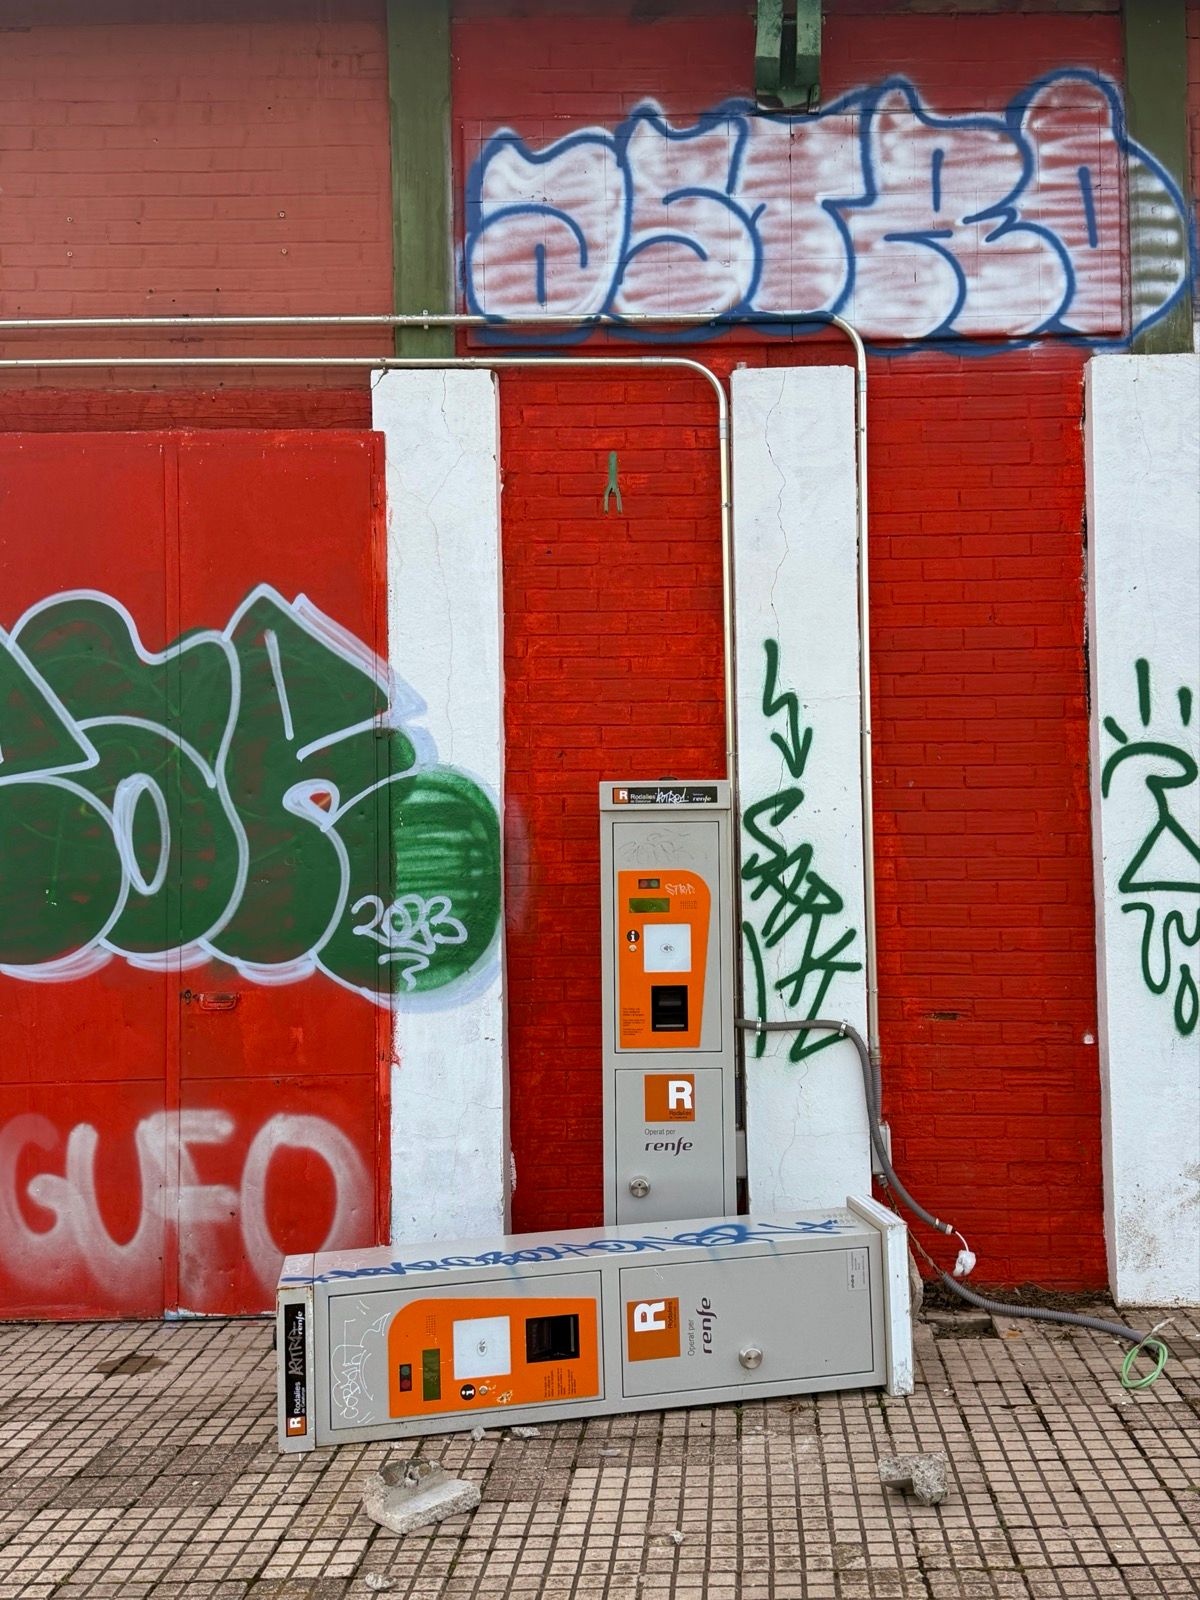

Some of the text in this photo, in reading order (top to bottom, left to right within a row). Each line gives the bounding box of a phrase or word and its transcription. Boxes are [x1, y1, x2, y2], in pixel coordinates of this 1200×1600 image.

[619, 790, 629, 800] R
[668, 1080, 693, 1109] R
[645, 1136, 693, 1157] renfe
[634, 1301, 666, 1332] R
[696, 1297, 717, 1354] renfe
[687, 1332, 696, 1356] Operat
[289, 1310, 305, 1429] R Rodalies renfe
